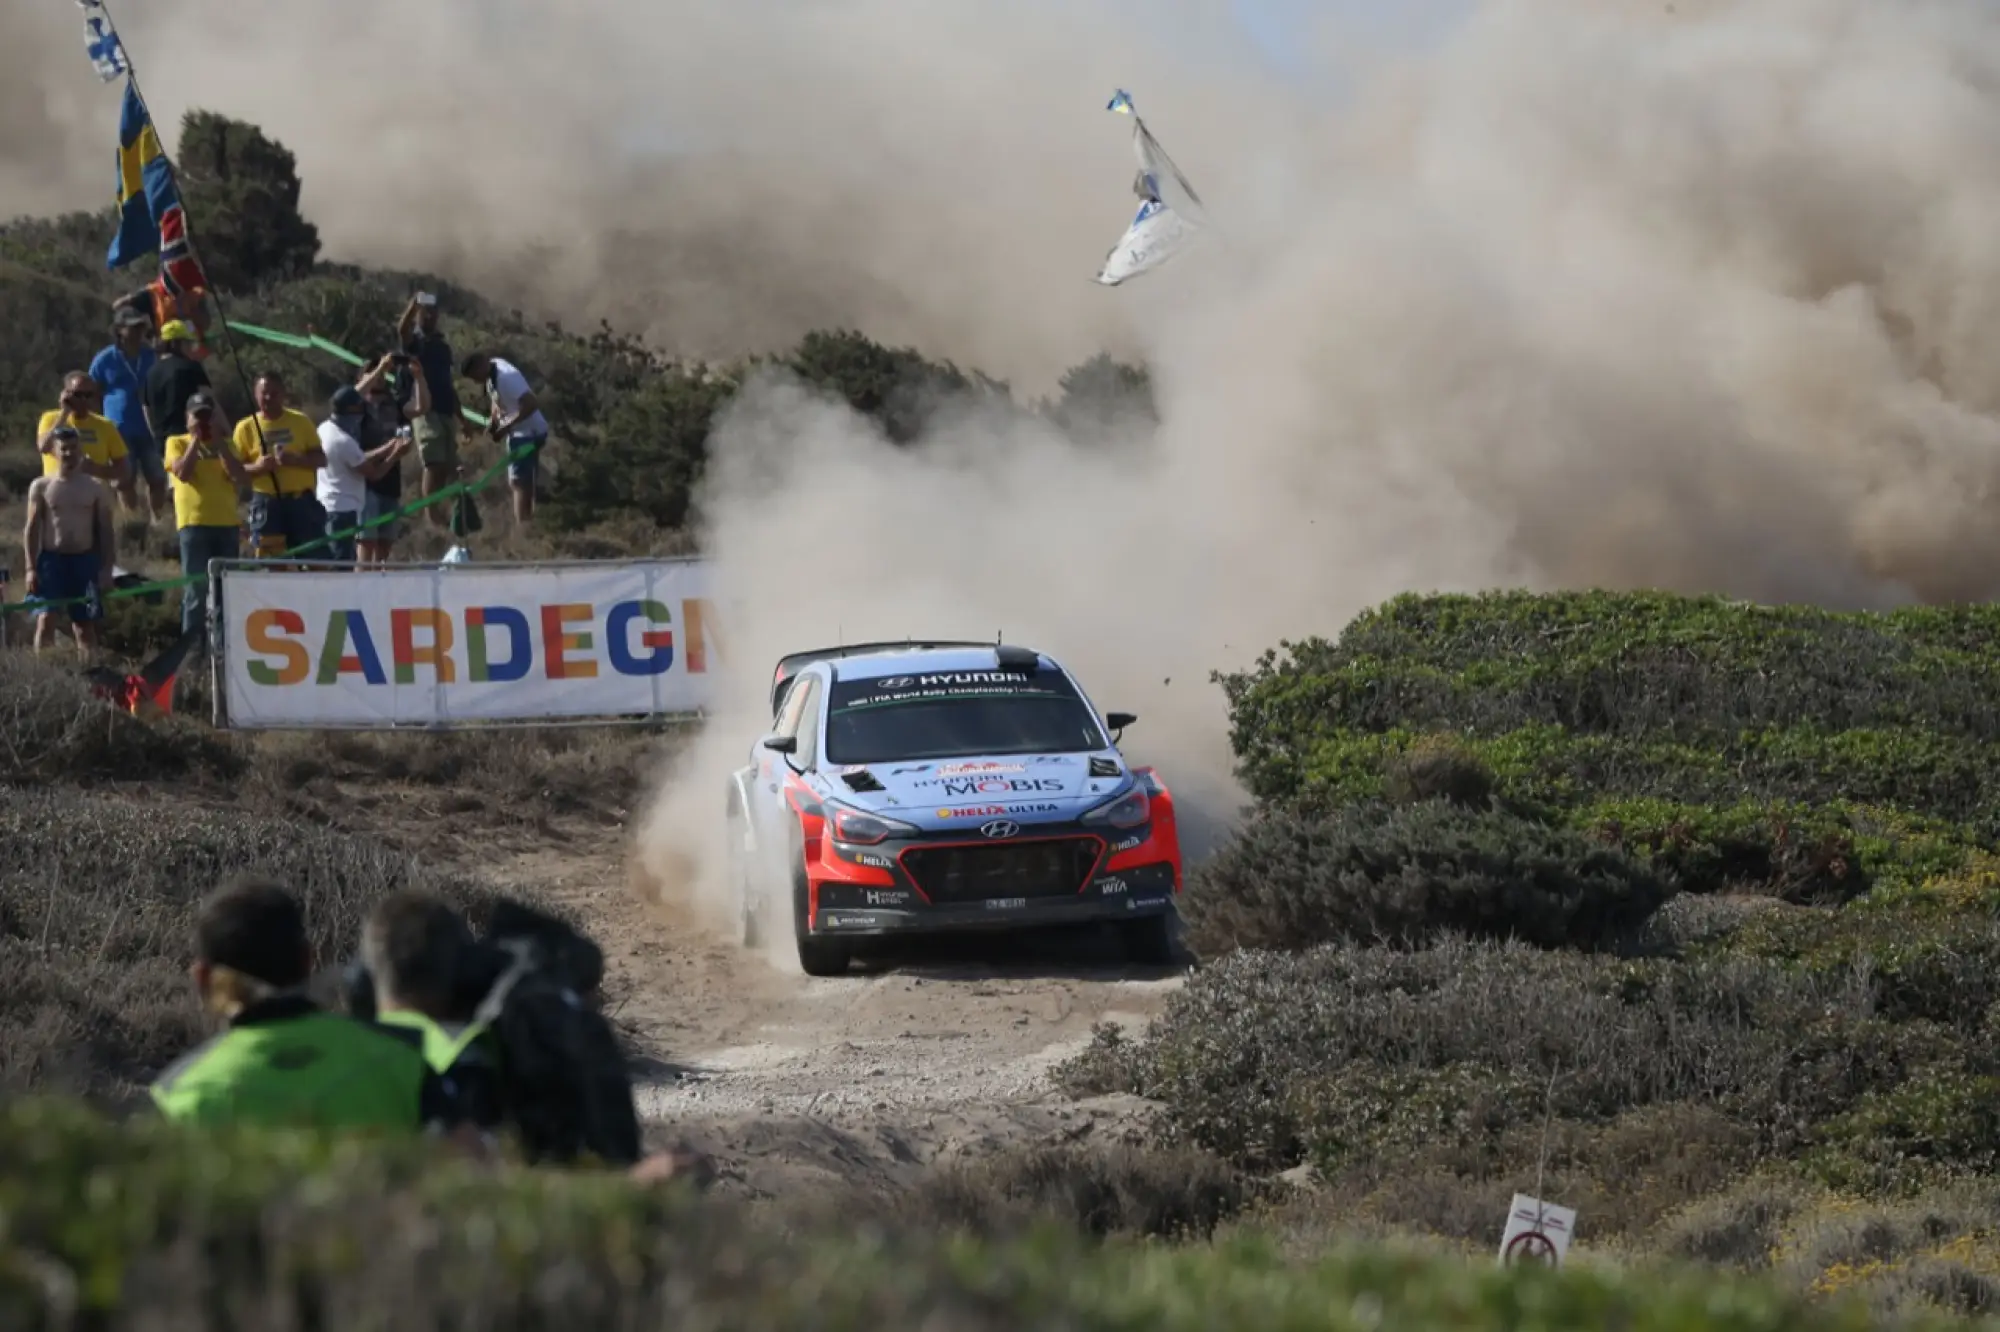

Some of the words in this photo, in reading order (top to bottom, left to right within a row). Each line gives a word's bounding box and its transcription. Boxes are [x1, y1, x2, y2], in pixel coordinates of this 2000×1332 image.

[920, 672, 1028, 685] HYUNDAI
[913, 774, 1004, 789] HYUNDAI
[944, 777, 1065, 797] MOBIS
[952, 804, 1007, 818] HELIX
[1008, 802, 1059, 814] ULTRA
[863, 854, 895, 869] HELIX
